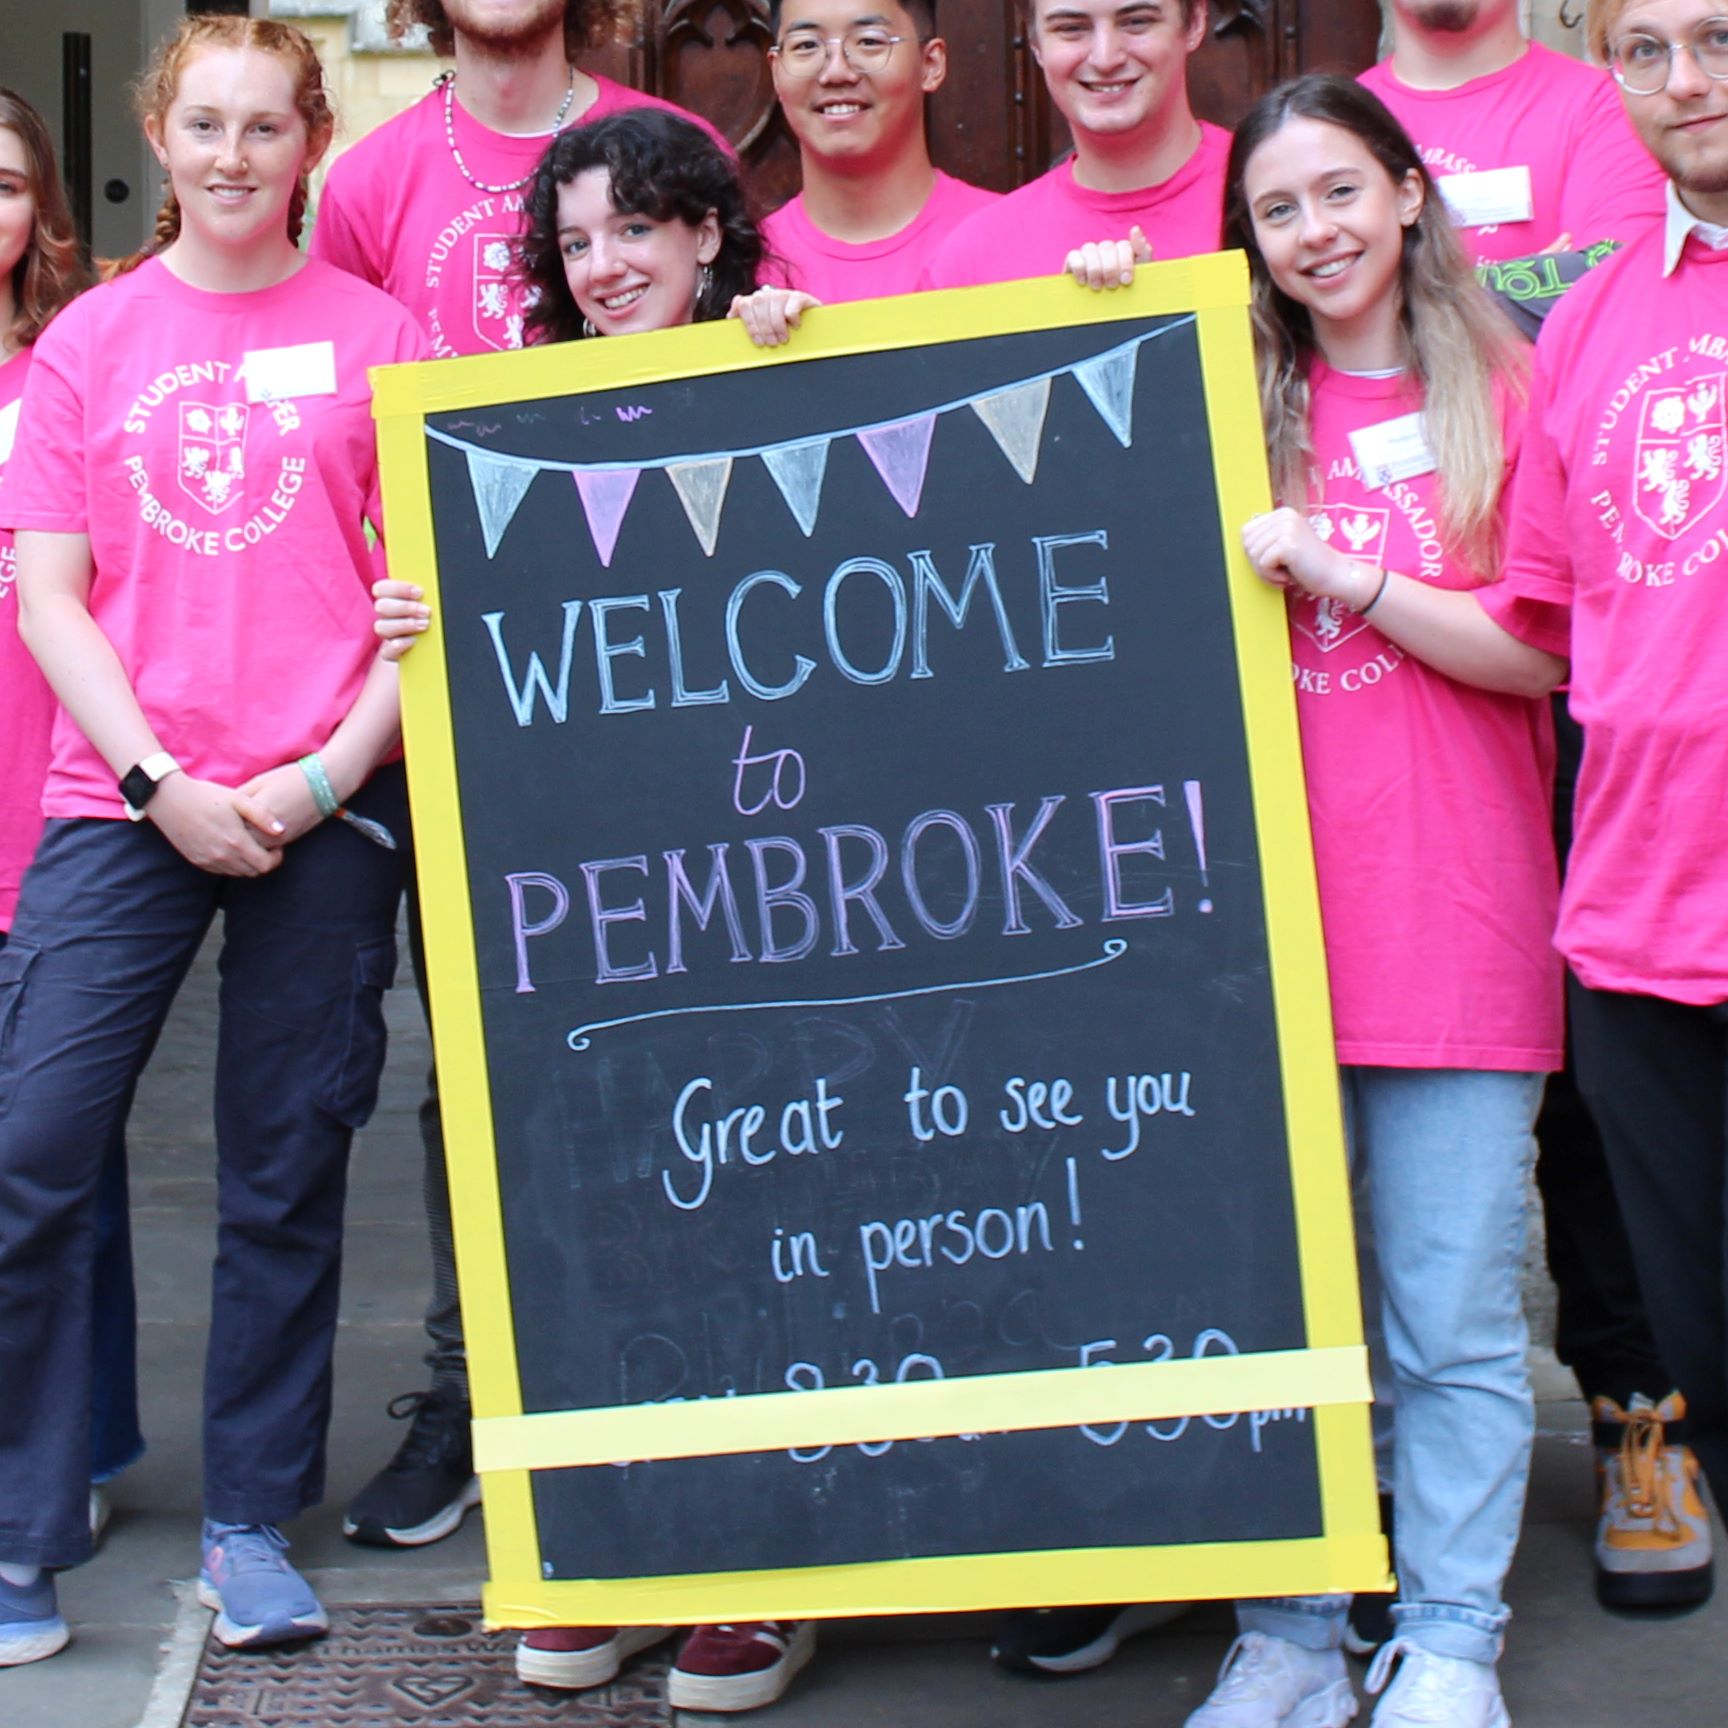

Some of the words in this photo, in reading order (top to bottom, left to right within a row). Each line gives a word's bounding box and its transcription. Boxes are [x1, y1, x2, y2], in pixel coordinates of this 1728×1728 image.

[426, 197, 496, 290] STUDENT
[123, 359, 232, 435] STUDENT
[1591, 345, 1679, 466] STUDENT
[224, 455, 306, 553] COLLEGE
[480, 528, 1115, 728] WELCOME
[731, 724, 806, 817] to
[503, 779, 1215, 994] PEMBROKE!
[663, 1076, 845, 1210] Great
[903, 1066, 968, 1143] to
[999, 1074, 1083, 1132] see
[1101, 1071, 1196, 1162] you
[771, 1228, 829, 1284] in
[860, 1155, 1087, 1314] person!
